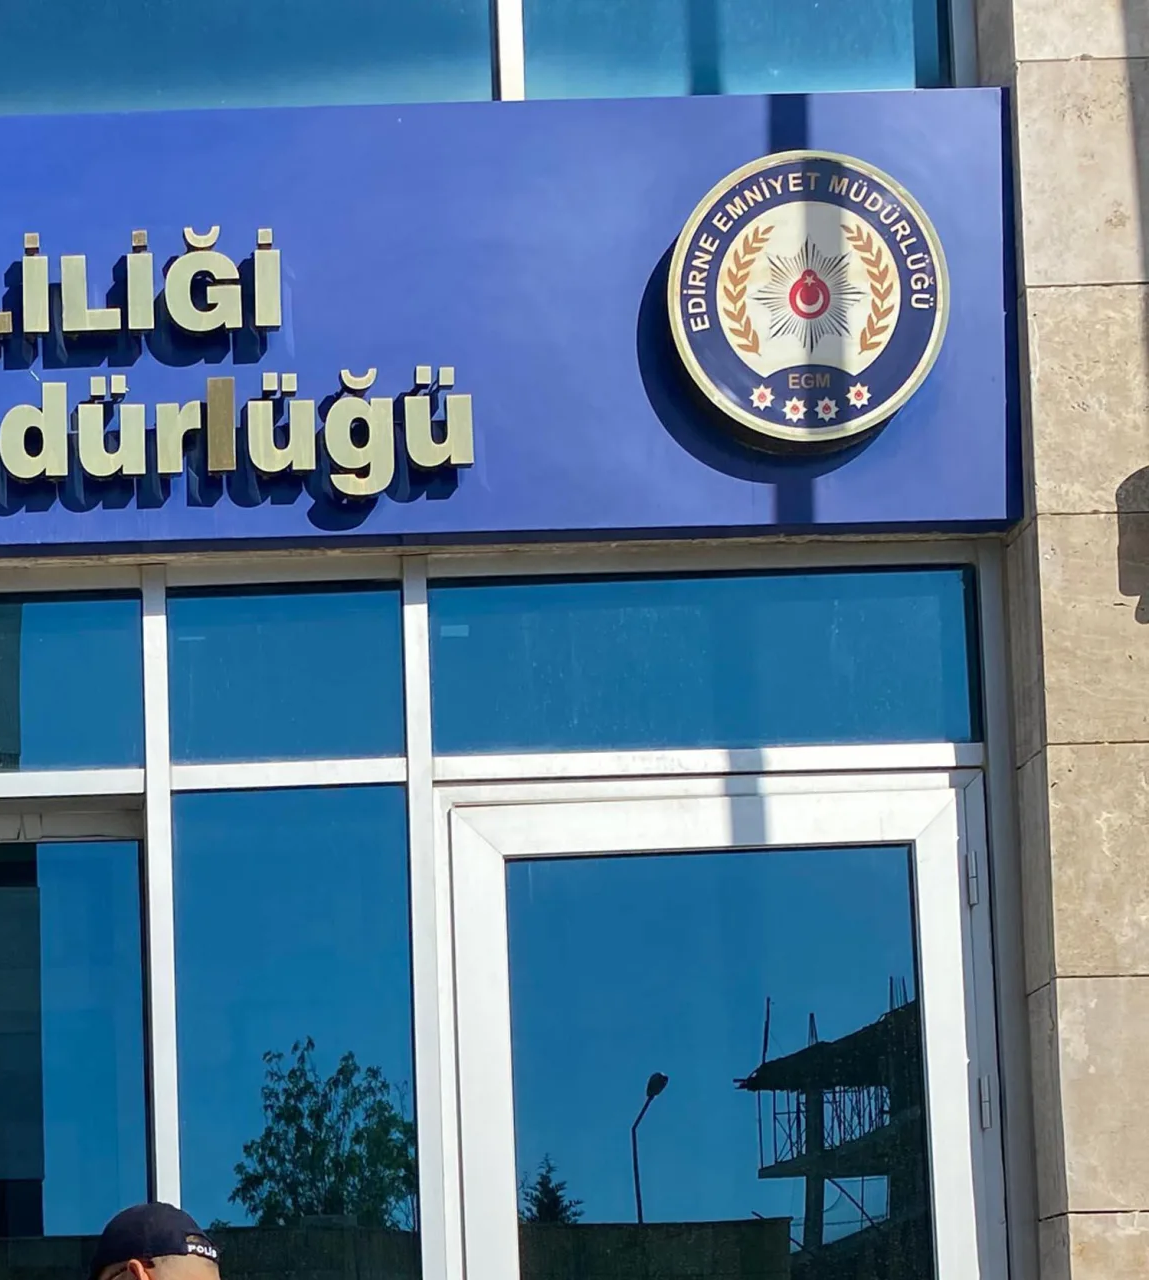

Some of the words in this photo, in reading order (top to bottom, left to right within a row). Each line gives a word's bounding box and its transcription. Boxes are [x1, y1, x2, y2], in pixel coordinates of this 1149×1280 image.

[683, 233, 720, 333] EDİRNE
[712, 172, 820, 233] EMNİYET
[828, 176, 935, 309] MÜDÜRLÜĞÜ
[788, 373, 831, 389] EGM
